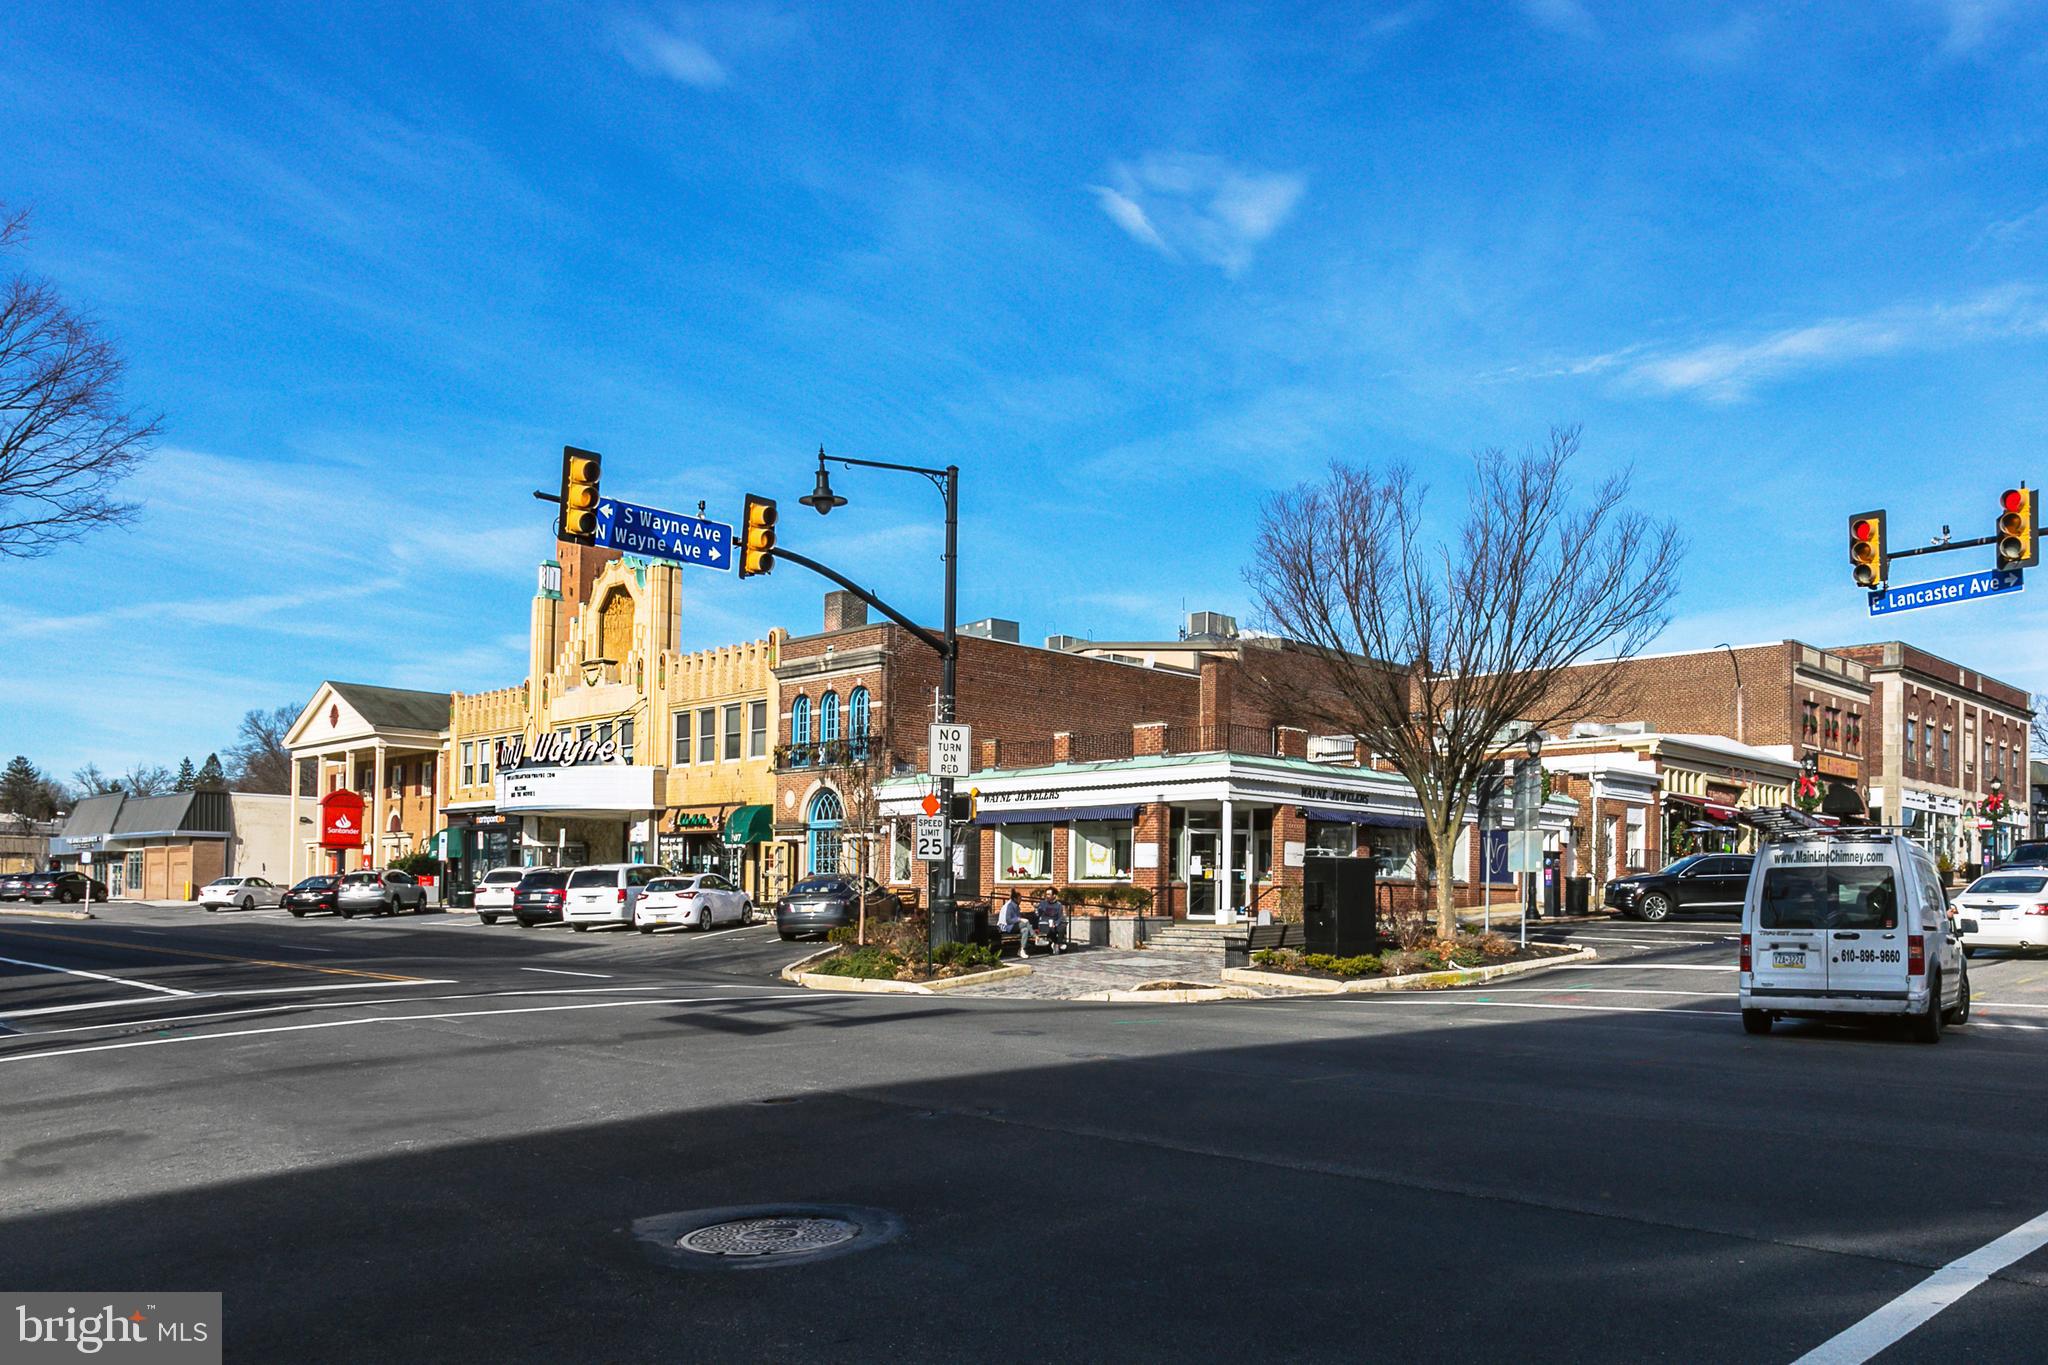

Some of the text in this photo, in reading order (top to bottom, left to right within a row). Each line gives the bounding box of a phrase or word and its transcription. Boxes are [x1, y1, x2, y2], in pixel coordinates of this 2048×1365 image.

[624, 507, 721, 542] S Wayne Ave
[595, 523, 701, 558] N Wayne Ave
[1872, 578, 1999, 611] E. Lancaster Ave
[939, 729, 960, 741] NO
[531, 732, 617, 768] Wayne
[938, 743, 962, 752] TURN
[943, 753, 956, 763] ON
[941, 764, 959, 774] RED
[984, 791, 1060, 803] WAYNE JEWELERS
[1301, 787, 1369, 804] WAYNE JEWELERS
[919, 819, 943, 828] SPEED
[327, 827, 359, 835] Santander
[921, 829, 940, 837] LIMIT
[919, 838, 942, 855] 25
[1774, 850, 1884, 865] www.MainLineChimney.com
[1841, 949, 1901, 963] 610-896-9660
